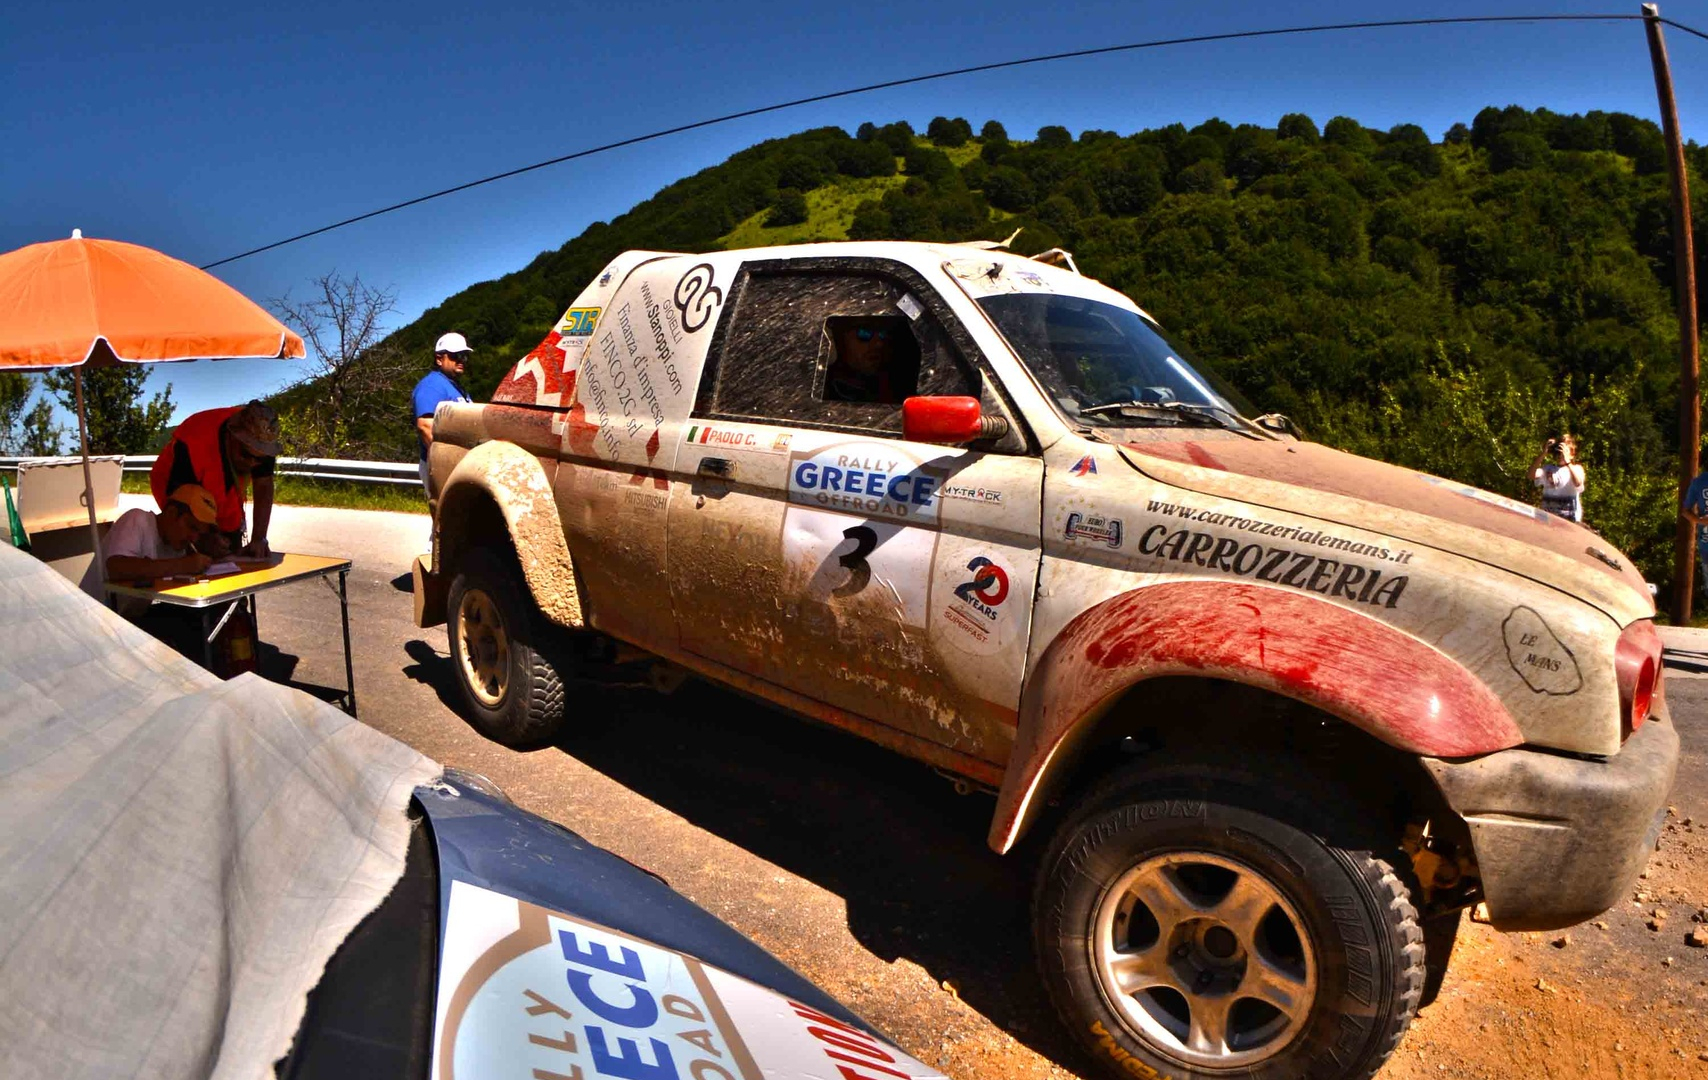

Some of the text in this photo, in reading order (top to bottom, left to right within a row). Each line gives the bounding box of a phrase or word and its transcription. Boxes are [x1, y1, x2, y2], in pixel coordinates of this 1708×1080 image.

[662, 299, 683, 345] GIOIELLI
[617, 302, 664, 427] Finanza d'impresa
[709, 430, 757, 446] PAOLO C.
[838, 455, 898, 472] RALLY
[624, 489, 668, 510] MITSUBISHI
[795, 462, 935, 506] GREECE
[816, 492, 908, 517] OFFROAD
[1146, 500, 1414, 565] www.carrozzerialemans.it
[832, 526, 878, 598] 3
[1138, 524, 1410, 609] CARROZZERIA
[953, 556, 1009, 606] 20
[967, 595, 998, 620] YEARS
[943, 611, 988, 642] SUPERFAST
[1519, 633, 1538, 647] LE
[1523, 653, 1562, 672] MANS
